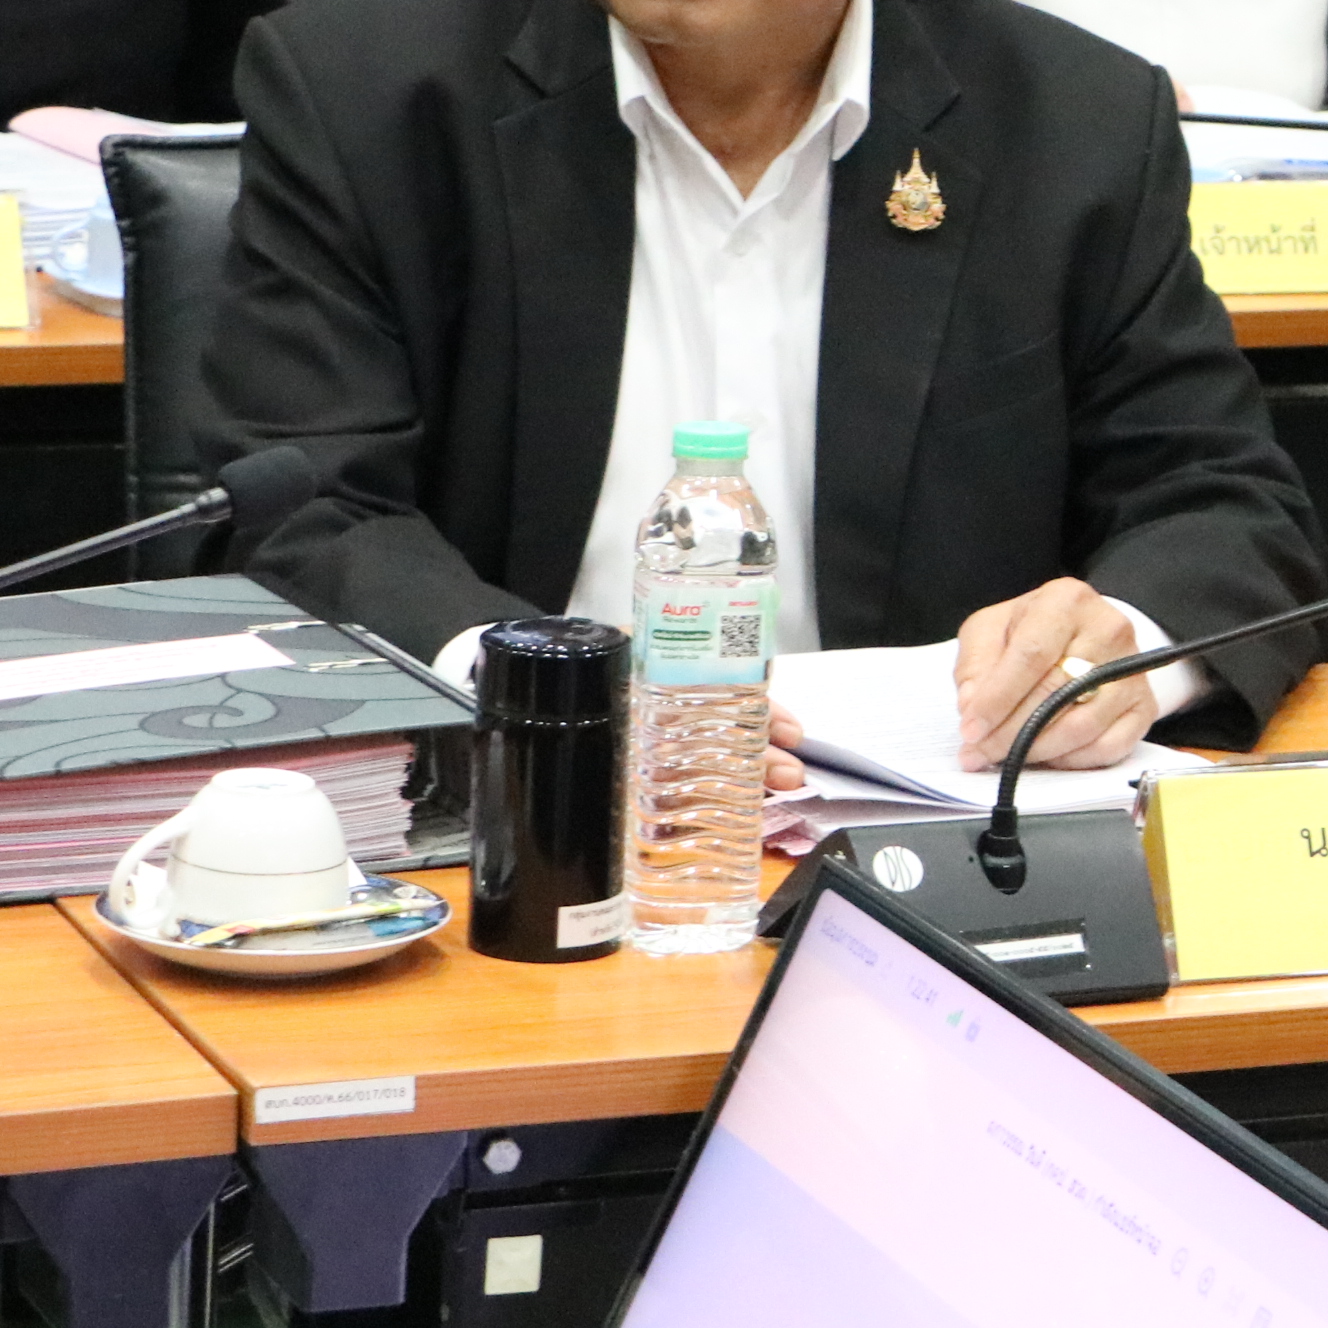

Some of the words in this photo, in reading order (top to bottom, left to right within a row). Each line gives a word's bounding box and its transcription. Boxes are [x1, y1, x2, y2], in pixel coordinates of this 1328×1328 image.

[1198, 217, 1318, 257] เจ้าหน้าที่
[661, 602, 702, 616] Aura
